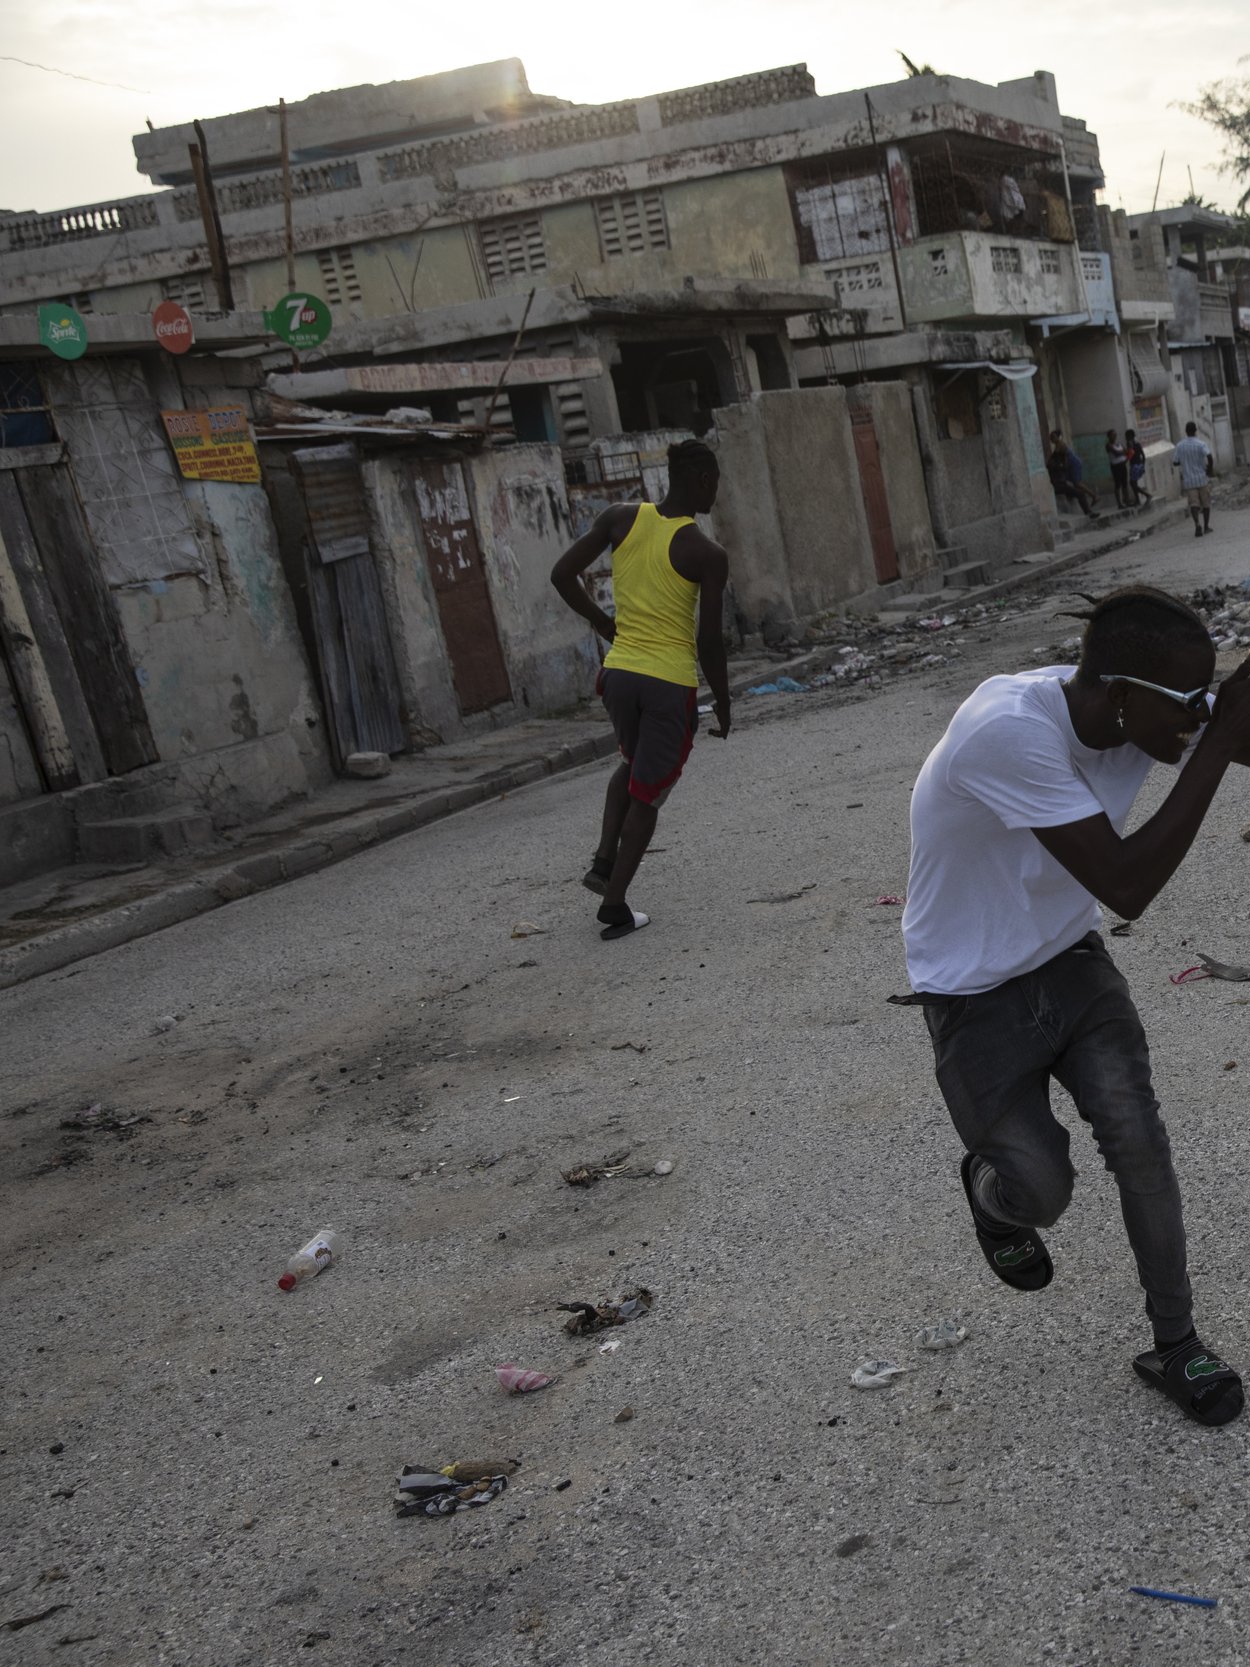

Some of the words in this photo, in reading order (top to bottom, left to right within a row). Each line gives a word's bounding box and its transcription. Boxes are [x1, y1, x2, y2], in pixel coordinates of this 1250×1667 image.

[51, 327, 77, 340] Sprite
[156, 318, 188, 337] Coca-Cola
[167, 415, 201, 433] ROSIE
[208, 410, 241, 432] DEPOT
